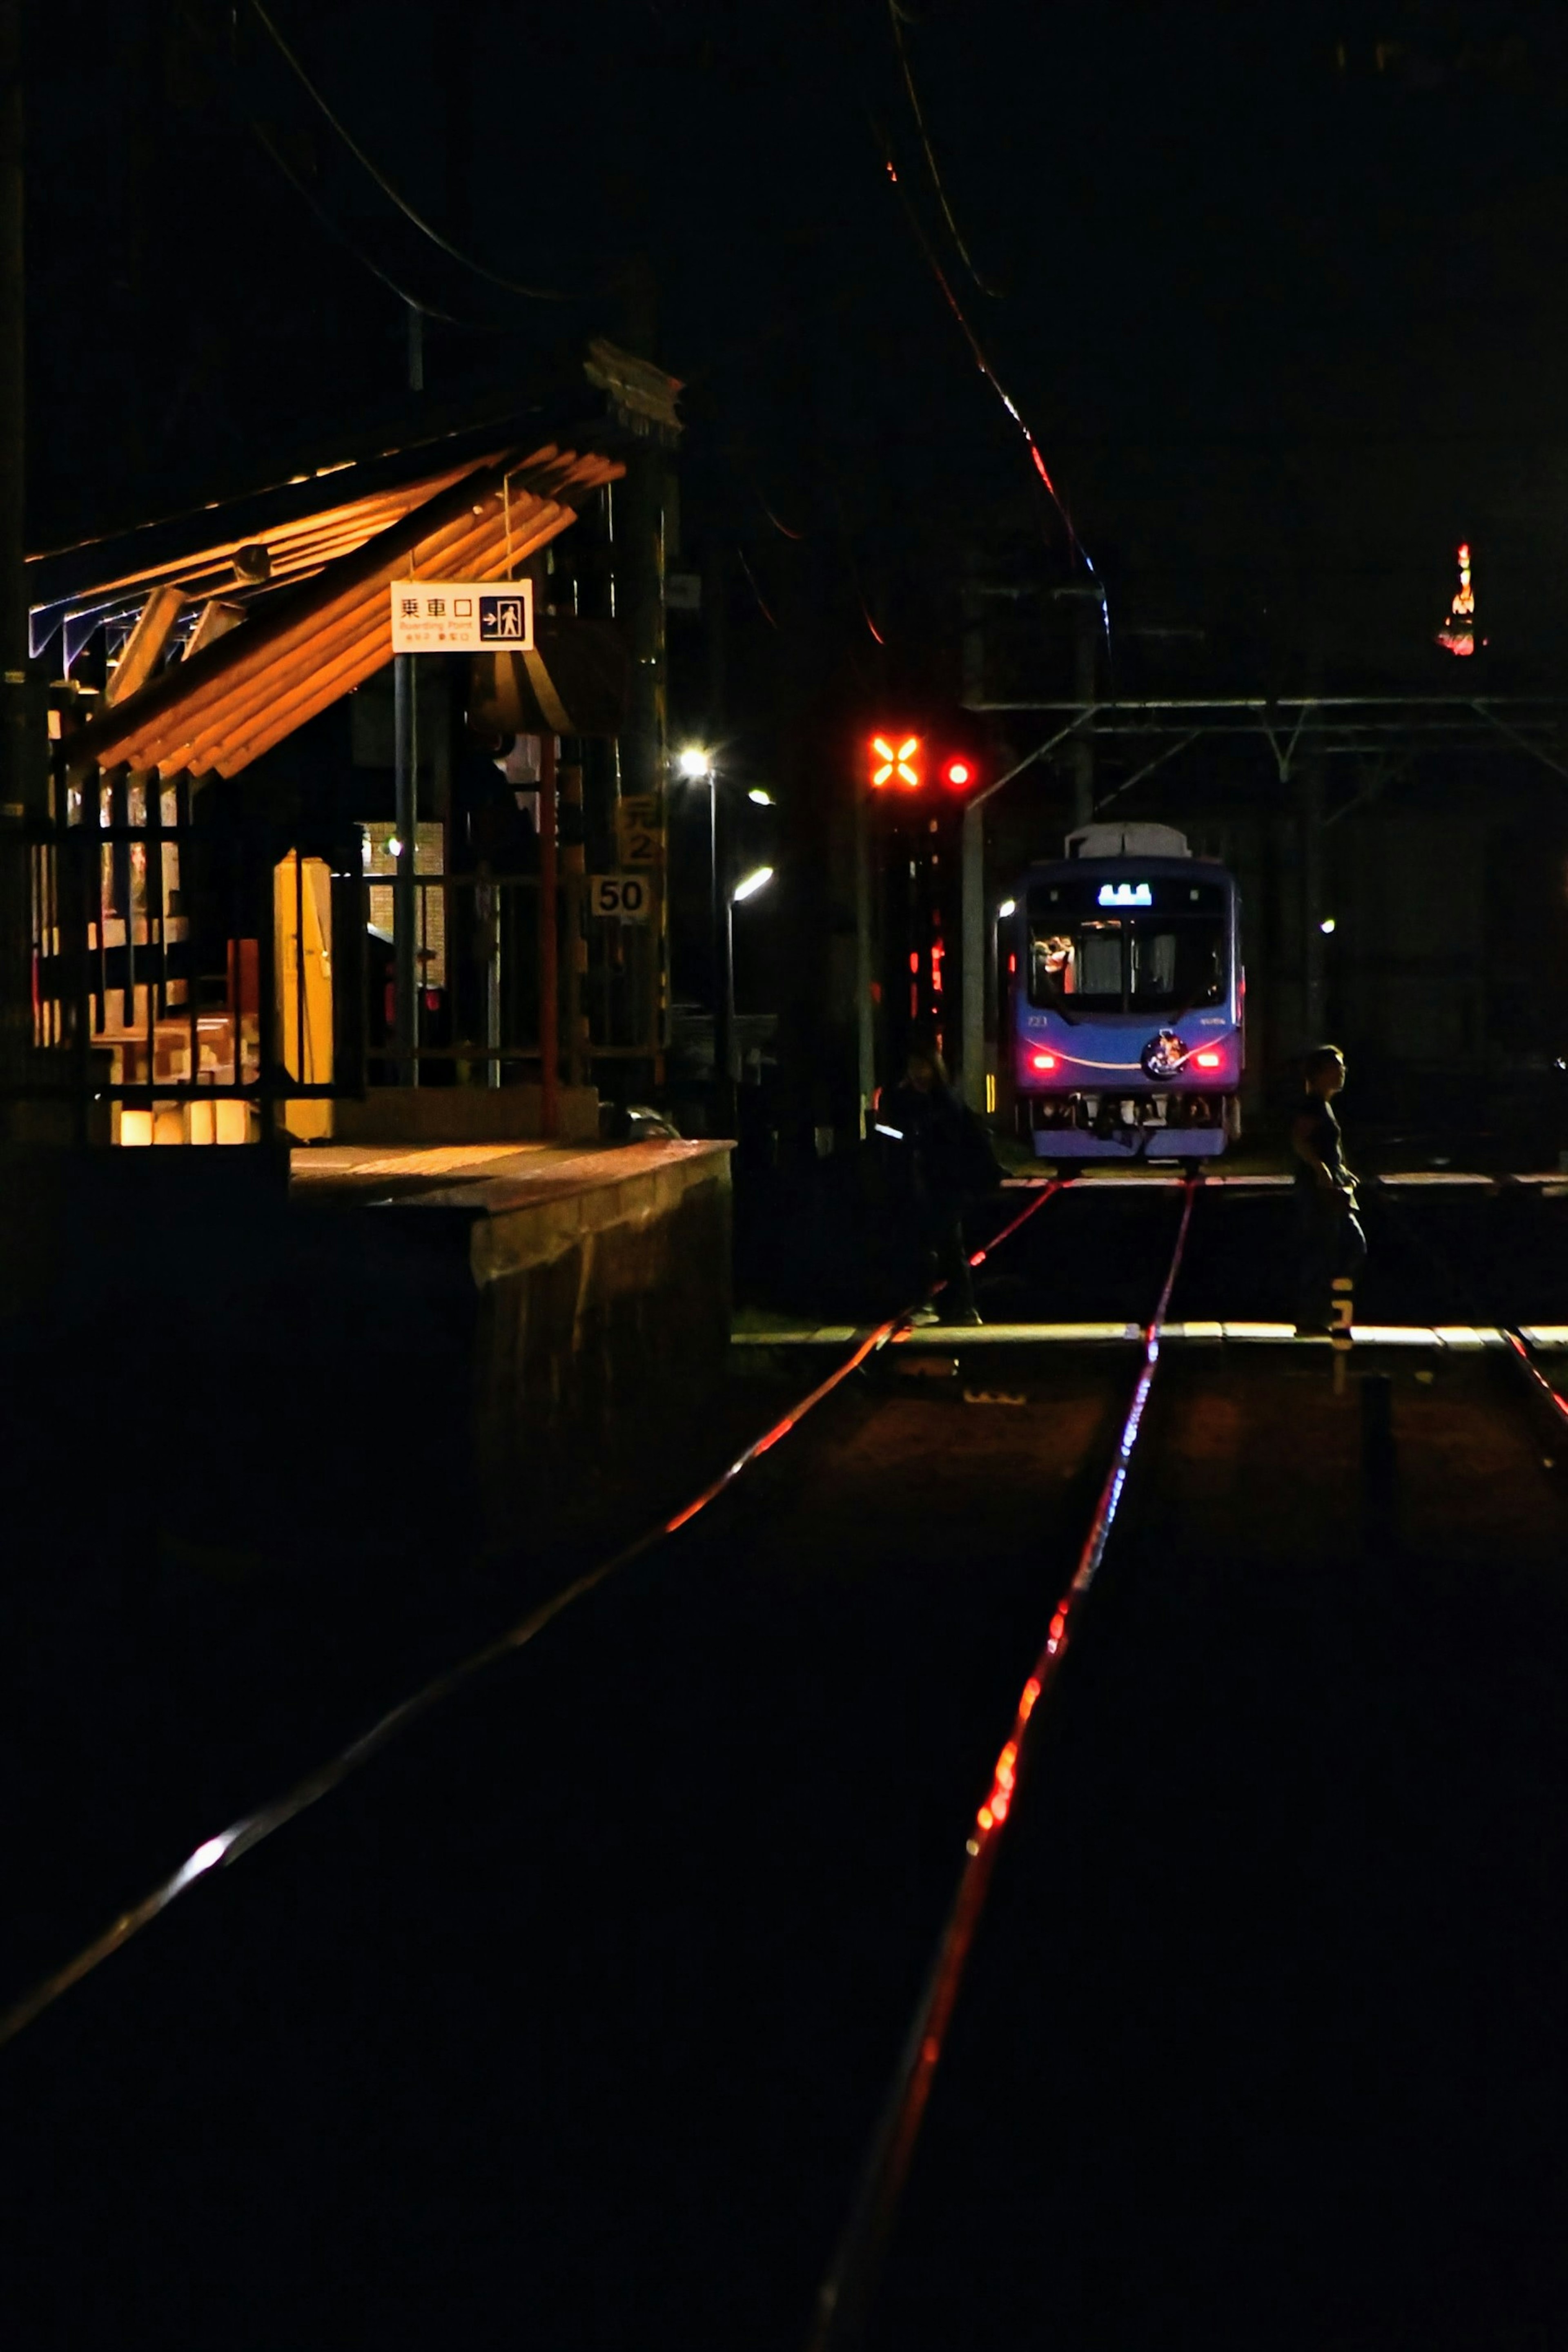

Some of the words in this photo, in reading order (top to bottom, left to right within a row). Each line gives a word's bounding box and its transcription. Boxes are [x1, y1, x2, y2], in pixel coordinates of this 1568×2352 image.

[401, 599, 472, 618] 乗車口
[599, 881, 642, 911] 50
